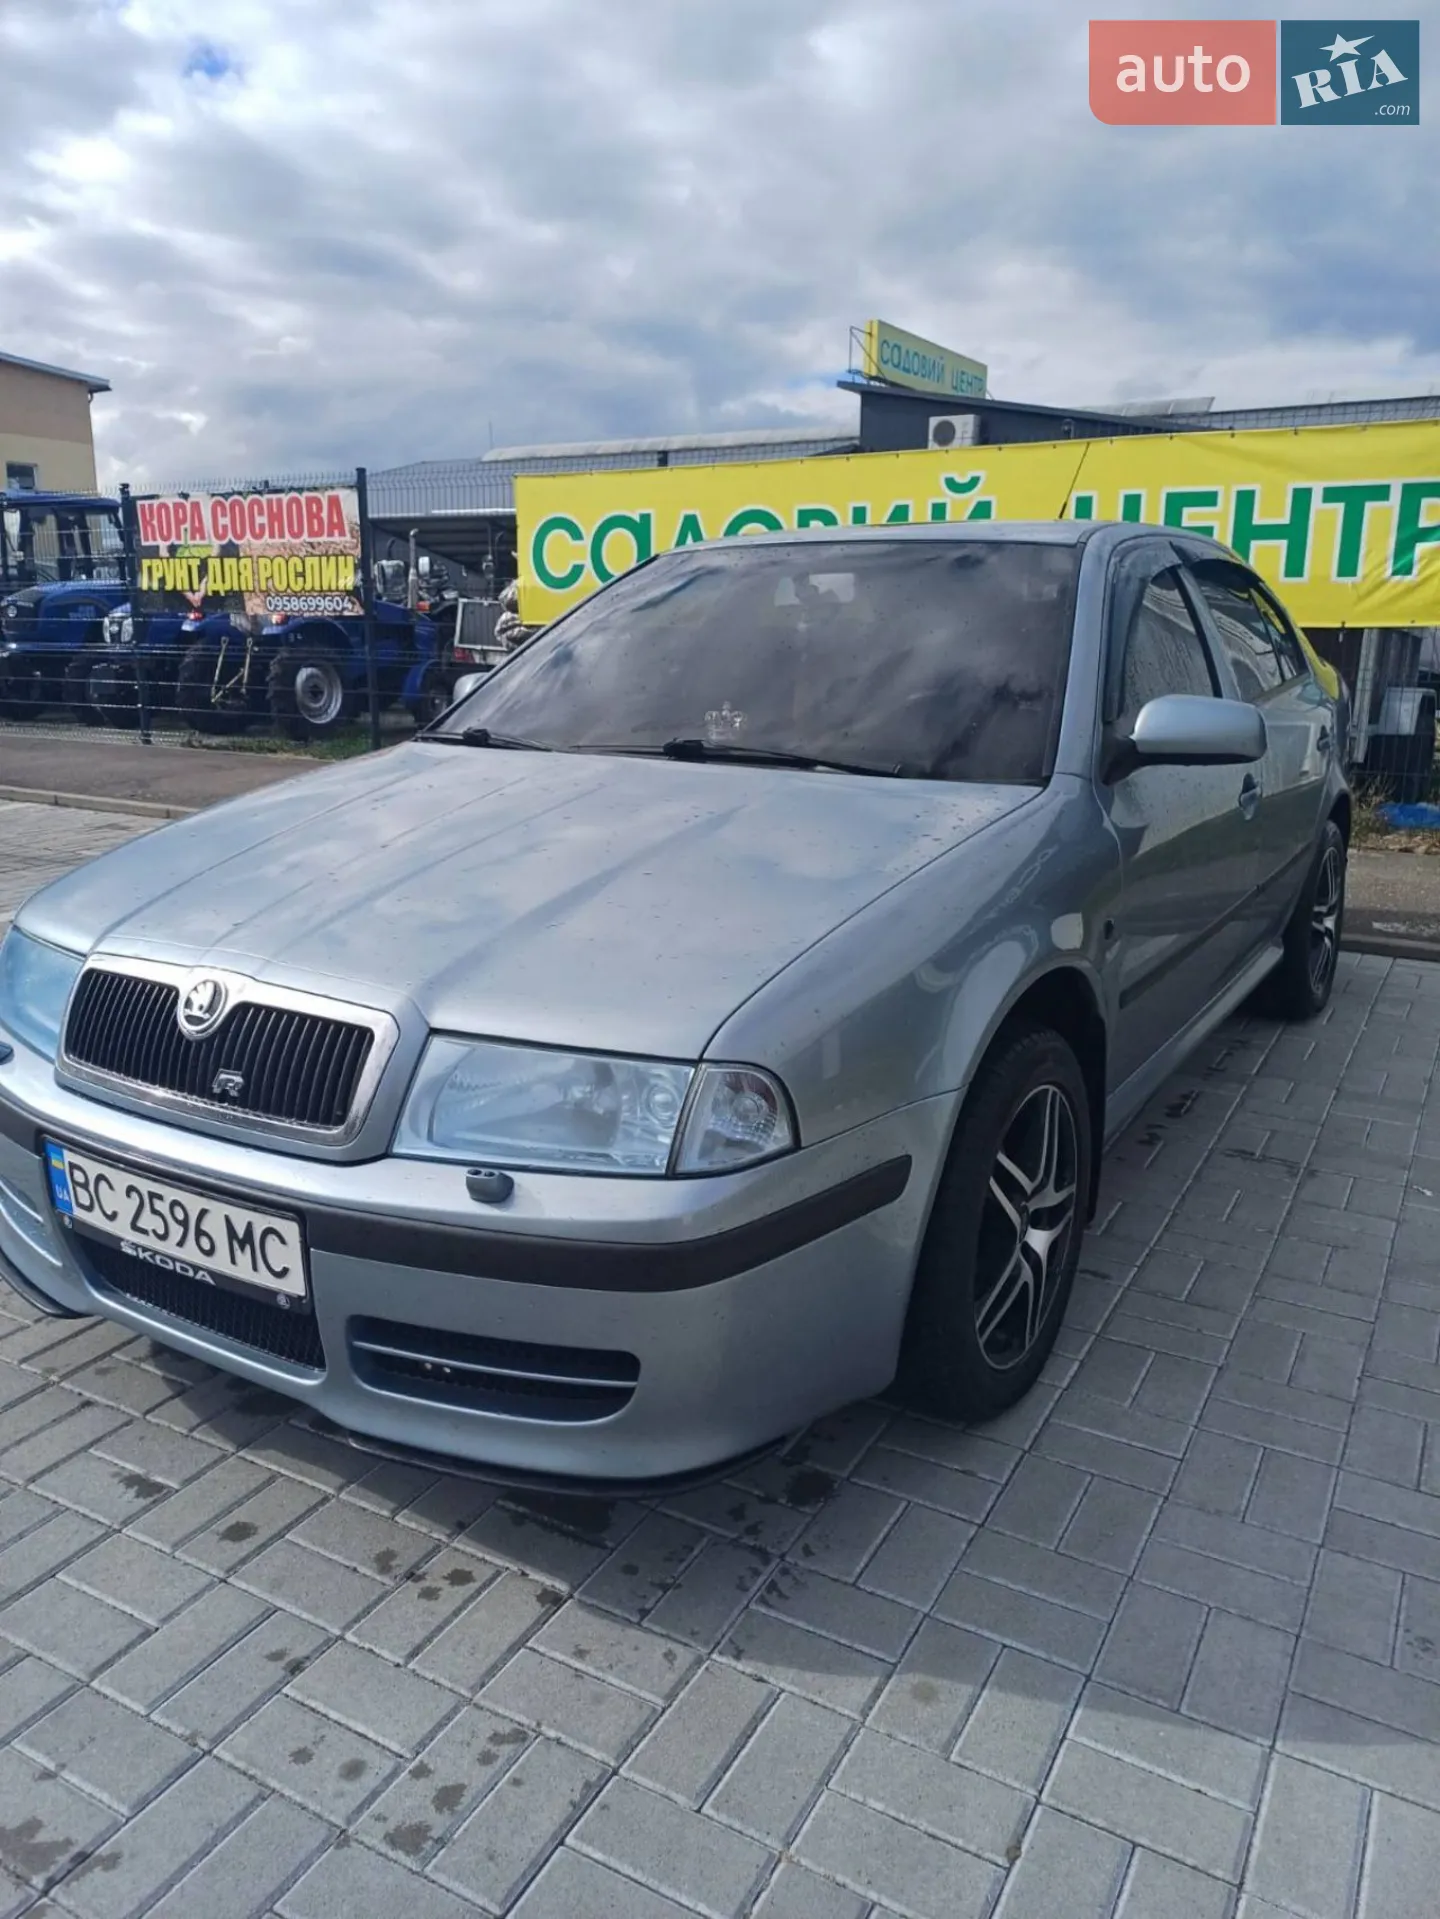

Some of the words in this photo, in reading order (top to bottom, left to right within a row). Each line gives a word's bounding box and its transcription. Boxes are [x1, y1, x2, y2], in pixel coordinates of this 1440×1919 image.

[951, 367, 984, 393] ЦЕНТР
[139, 501, 206, 543] КОРА
[210, 494, 347, 542] СОСНОВА
[141, 557, 201, 591] ГРУНТ
[206, 556, 254, 595] ДЛЯ
[257, 554, 355, 592] РОСЛИН
[266, 596, 352, 612] 0958699604
[68, 1160, 118, 1222] BC
[125, 1184, 216, 1257] 2596
[224, 1214, 290, 1279] MC
